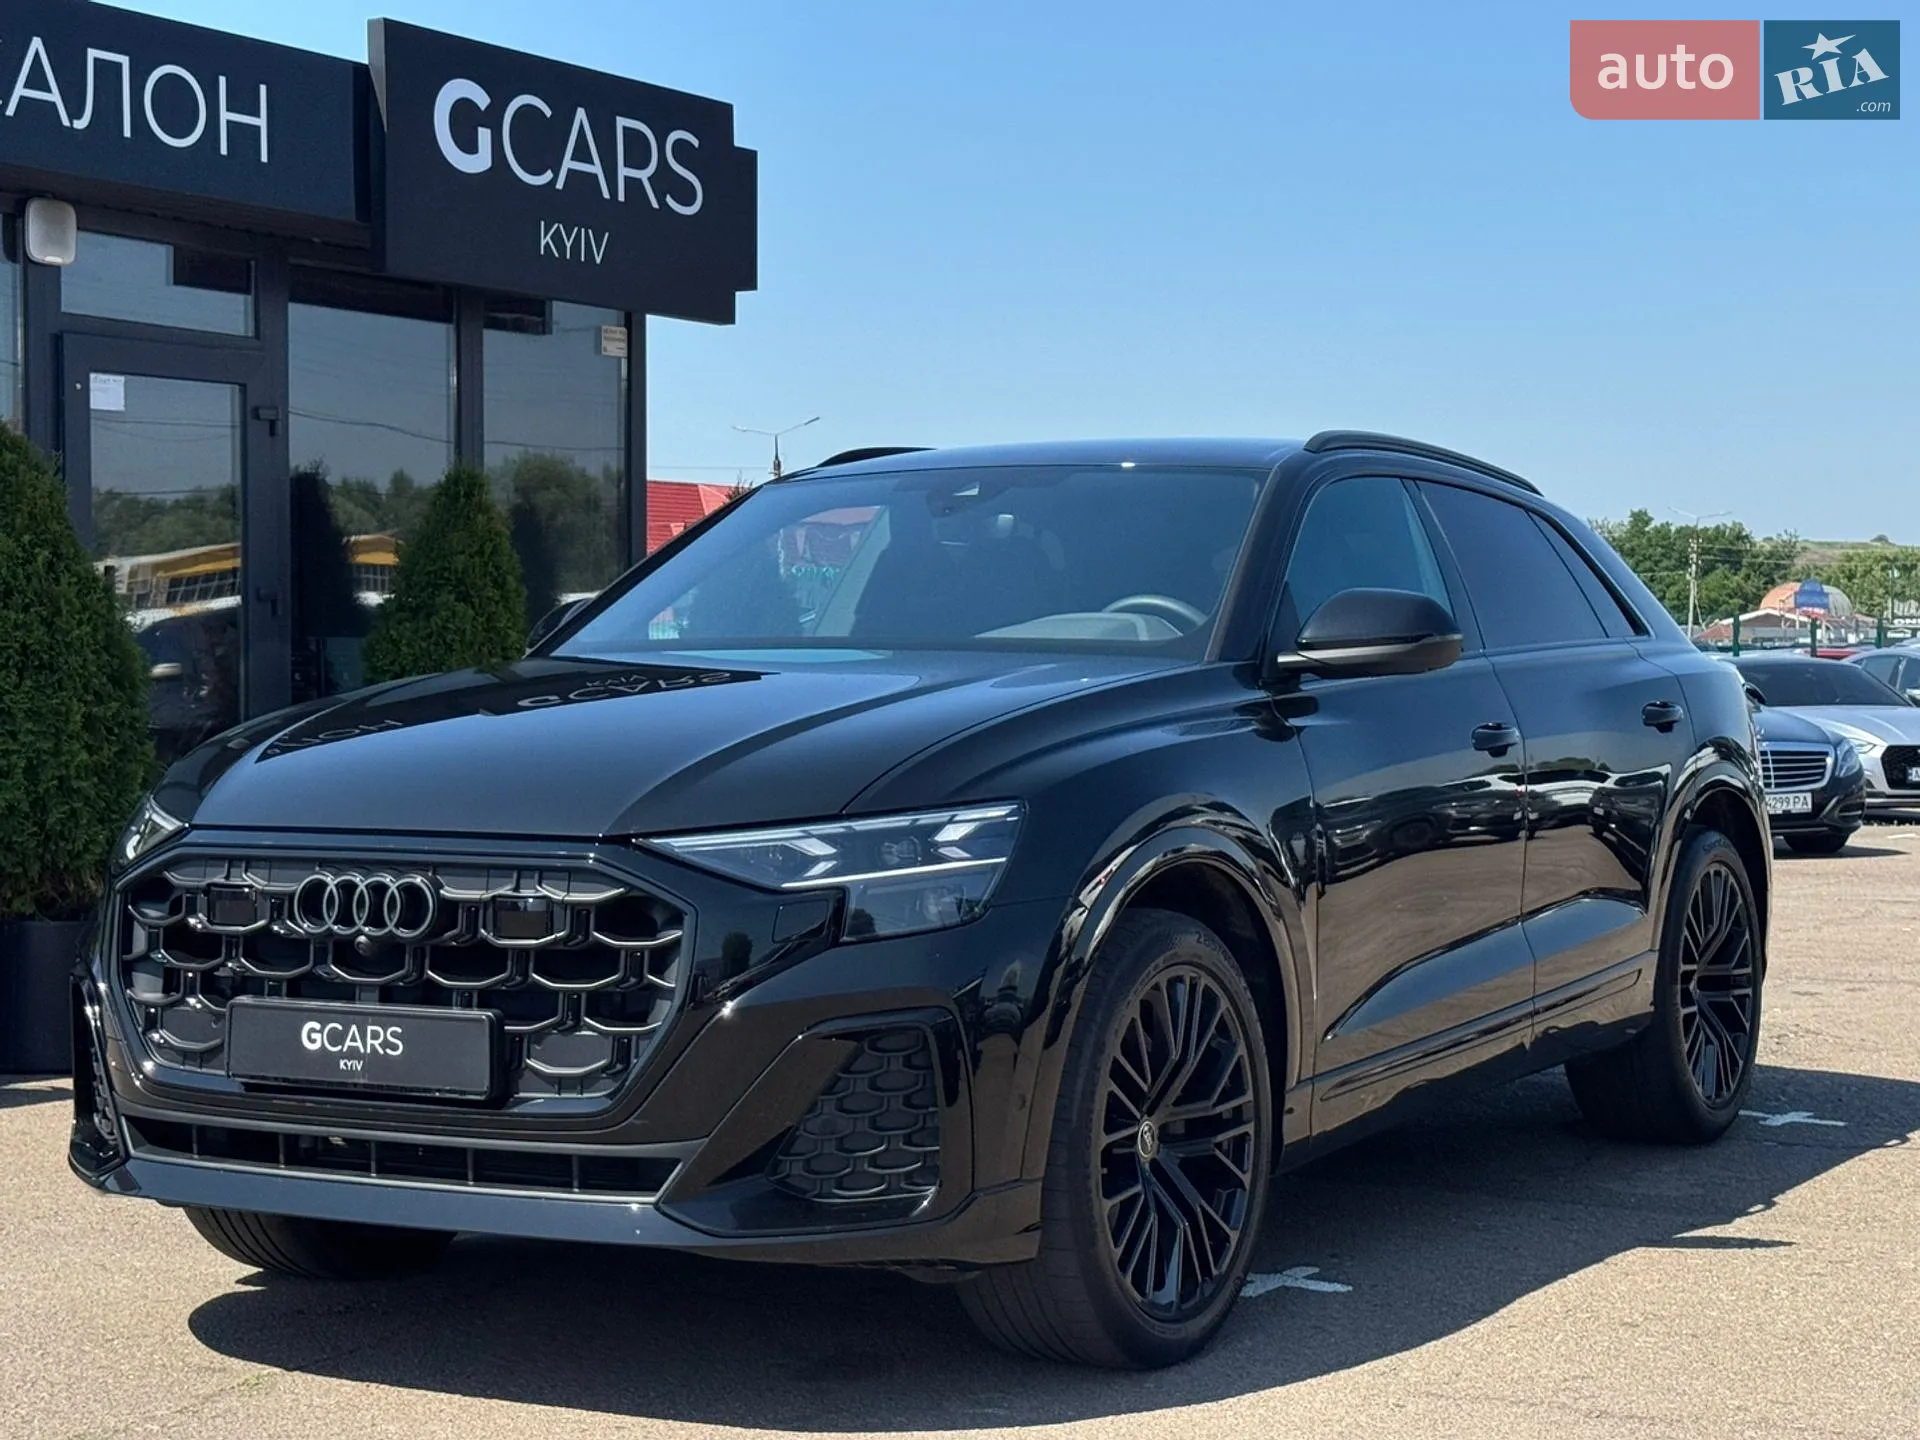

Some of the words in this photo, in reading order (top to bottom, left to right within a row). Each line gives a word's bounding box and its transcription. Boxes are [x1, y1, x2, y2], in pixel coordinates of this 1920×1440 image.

[0, 37, 269, 163] АЛОН
[433, 78, 704, 216] GCARS
[539, 220, 609, 265] KYIV
[301, 1021, 404, 1056] GCARS
[339, 1058, 364, 1072] KYIV
